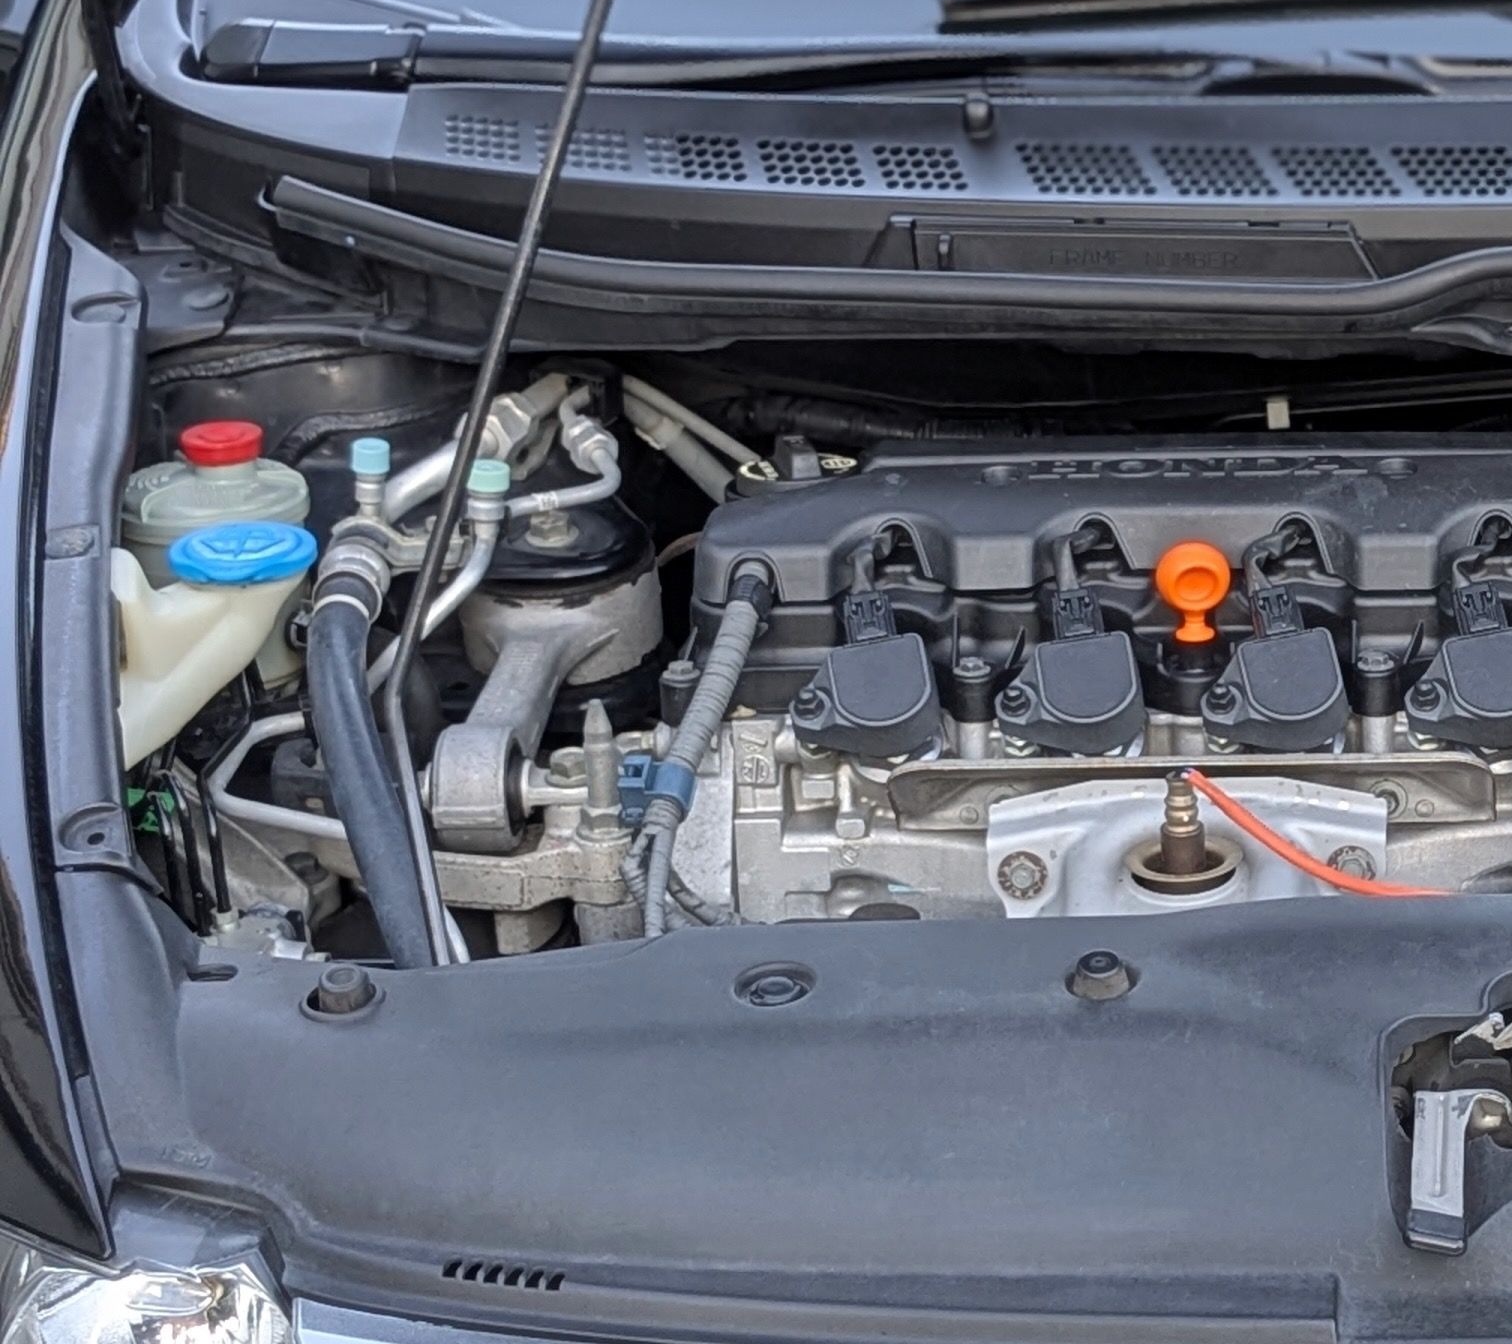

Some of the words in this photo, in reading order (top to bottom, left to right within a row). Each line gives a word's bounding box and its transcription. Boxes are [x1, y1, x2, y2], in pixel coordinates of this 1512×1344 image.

[1049, 247, 1122, 266] FRAME
[1144, 249, 1239, 268] NUMBER
[1028, 456, 1369, 479] HONDA
